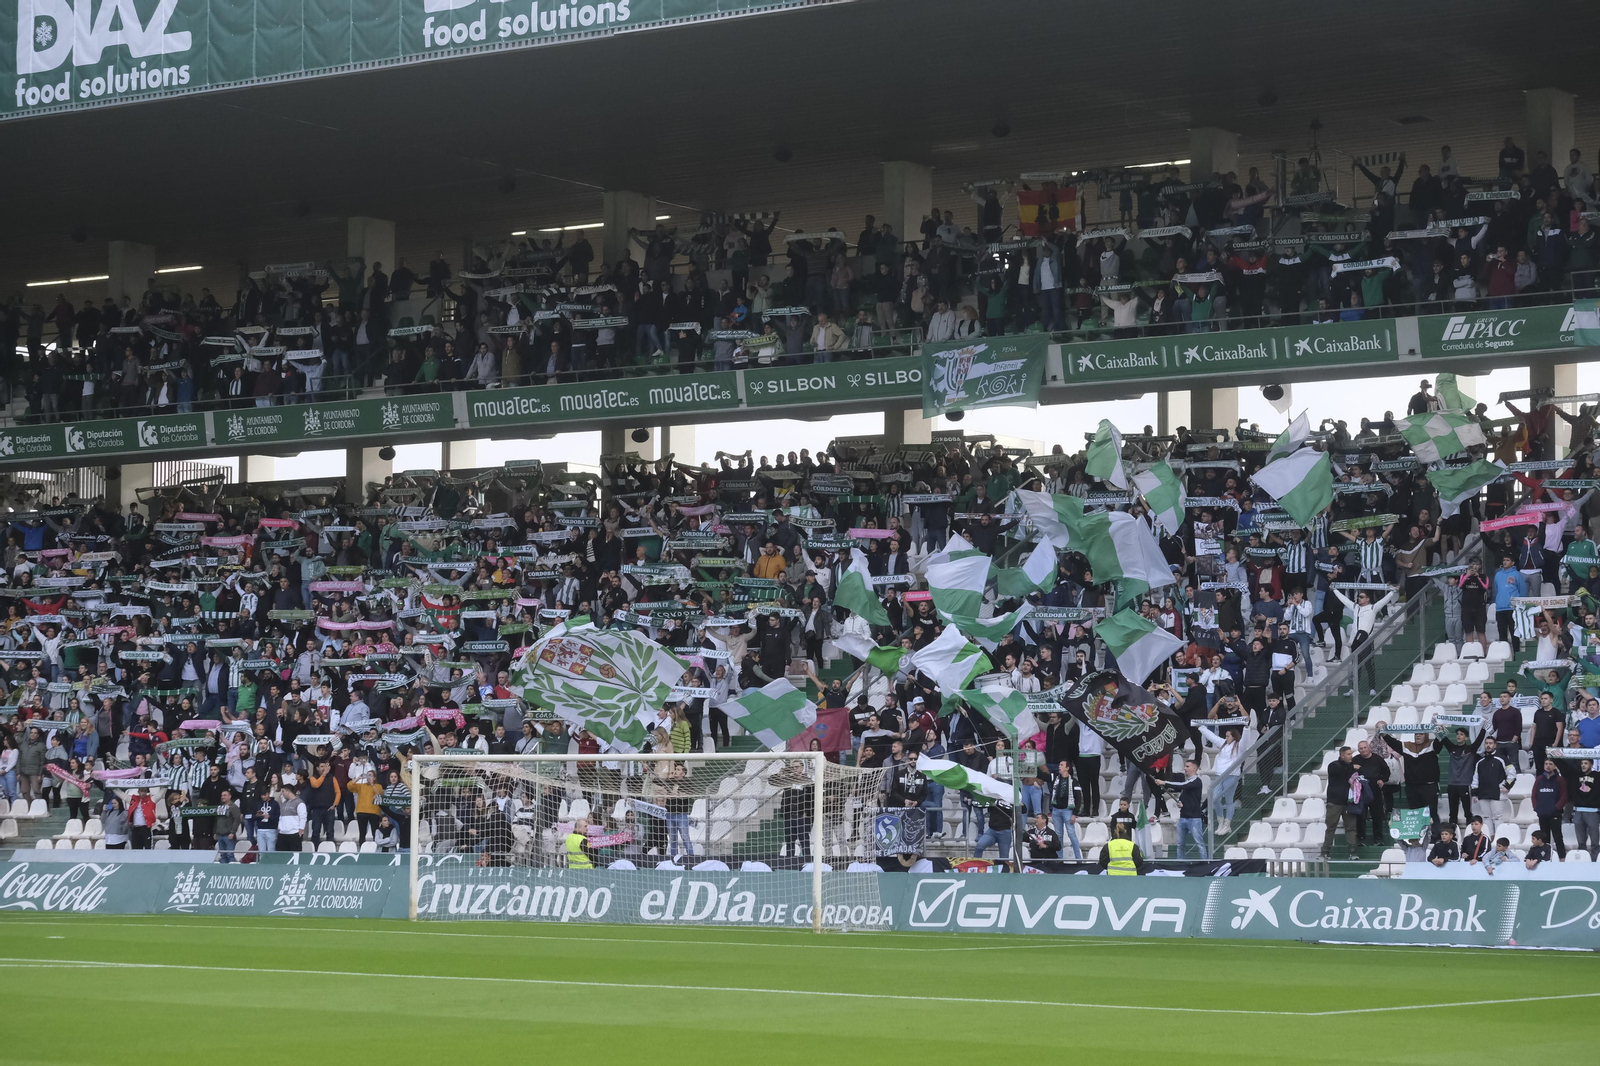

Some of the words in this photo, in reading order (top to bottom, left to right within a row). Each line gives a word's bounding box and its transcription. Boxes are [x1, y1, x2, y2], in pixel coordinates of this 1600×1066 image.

[423, 17, 486, 48] food
[498, 0, 631, 40] solutions
[15, 72, 70, 108] food
[79, 62, 190, 99] solutions
[1469, 318, 1526, 339] PACC
[1314, 335, 1381, 353] CaixaBank
[1485, 340, 1514, 349] Seguros
[1203, 344, 1268, 361] CaixaBank
[1096, 353, 1158, 370] CaixaBank
[767, 376, 836, 394] SILBON
[864, 369, 922, 386] SILBO
[322, 409, 360, 421] AYUNTAMIENTO
[401, 402, 440, 415] AYUNTAMIENTO
[246, 414, 282, 427] AYUNTAMIENTO
[87, 429, 122, 439] Diputación
[160, 424, 197, 434] Diputación
[16, 434, 50, 444] Diputación
[99, 439, 124, 447] Córdoba
[173, 433, 198, 442] Córdoba
[29, 444, 52, 452] Córdoba
[206, 874, 274, 891] AYUNTAMIENTO
[313, 877, 382, 892] AYUNTAMIENTO
[215, 894, 255, 907] CORDOBA
[322, 896, 363, 909] CORDOBA
[417, 875, 612, 922] Cruzcampo
[760, 904, 788, 925] DE
[957, 894, 1186, 932] GIVOVA
[1289, 890, 1486, 932] CaixaBank
